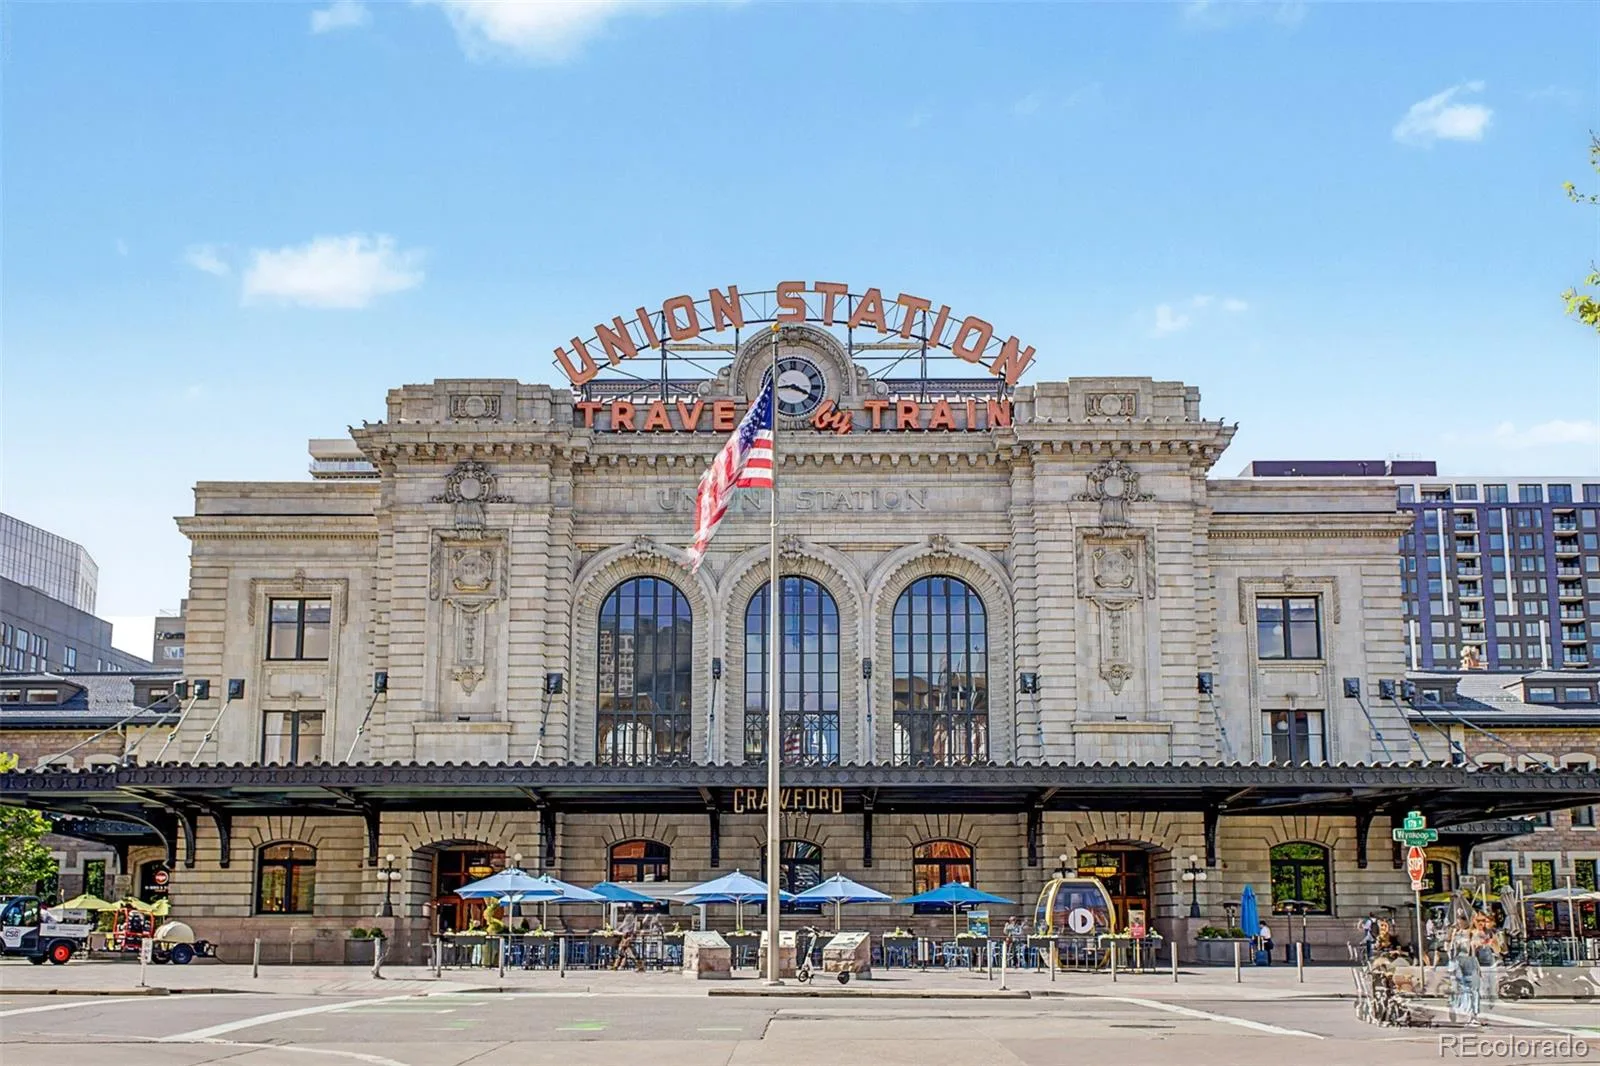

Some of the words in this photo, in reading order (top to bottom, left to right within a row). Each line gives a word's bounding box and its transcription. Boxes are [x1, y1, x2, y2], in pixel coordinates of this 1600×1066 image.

[553, 285, 744, 386] UNION
[776, 280, 1037, 386] STATION
[576, 400, 750, 431] TRAVE
[810, 399, 853, 435] by
[864, 399, 1011, 430] TRAIN
[657, 488, 762, 511] UNN
[796, 487, 928, 511] STATION
[734, 788, 842, 813] CRAWFORD
[778, 811, 809, 819] OTEL
[1396, 830, 1429, 841] Wynkoop
[1407, 857, 1424, 871] STOP
